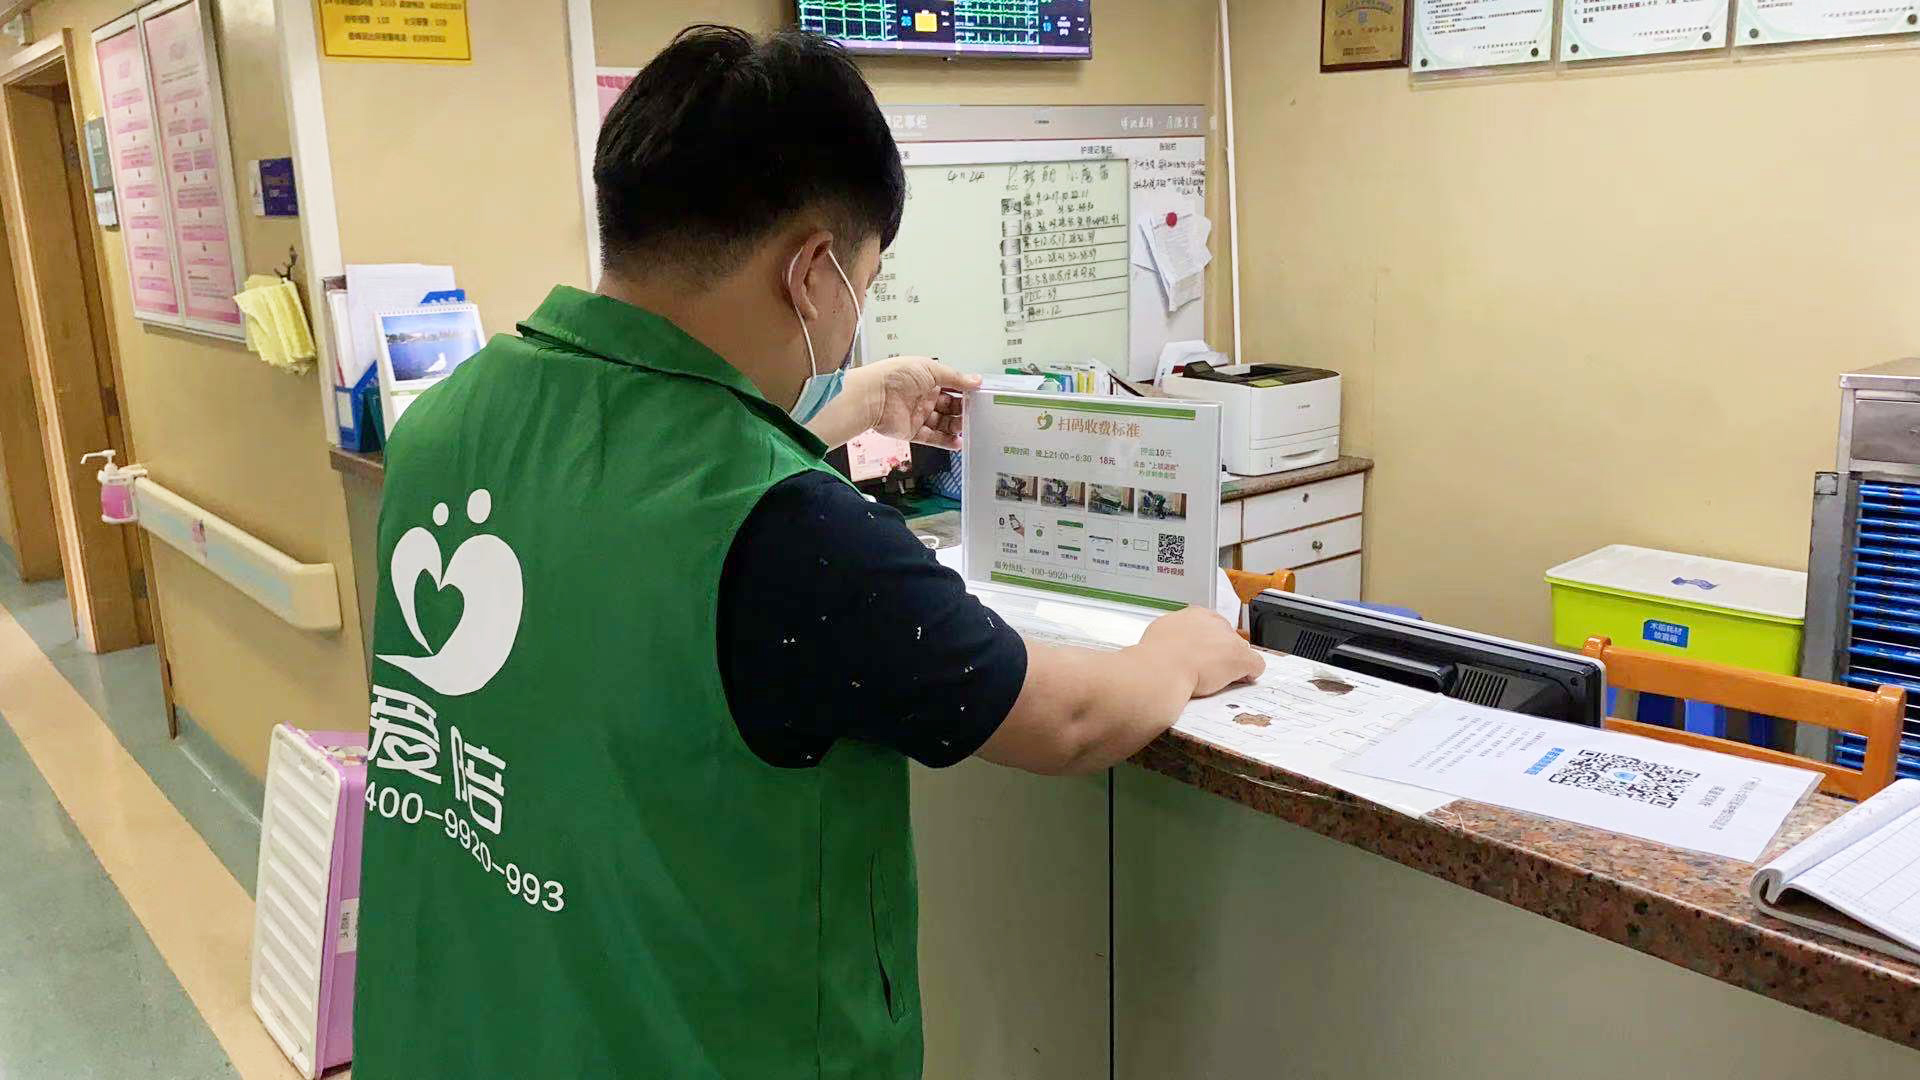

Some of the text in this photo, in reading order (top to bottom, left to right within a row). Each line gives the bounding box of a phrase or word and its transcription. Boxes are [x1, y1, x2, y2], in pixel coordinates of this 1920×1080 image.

[1058, 417, 1142, 438] 扫码收费标准
[1157, 565, 1185, 577] 操作视频
[364, 781, 565, 912] 400-9920-993
